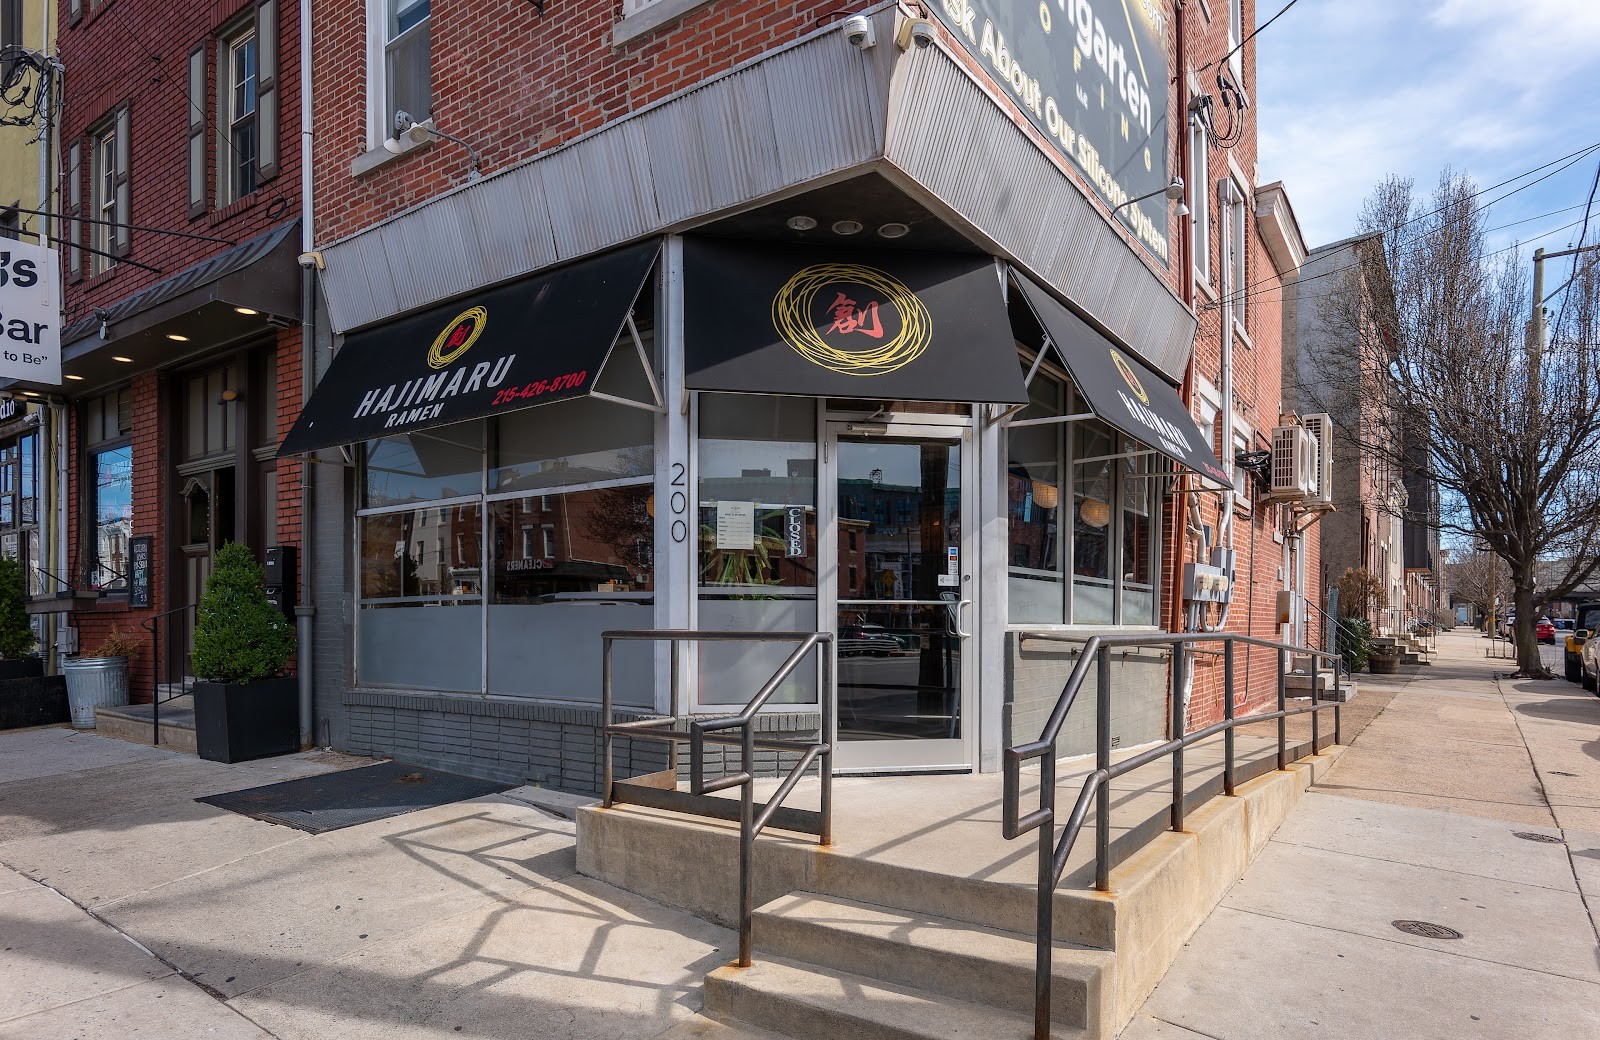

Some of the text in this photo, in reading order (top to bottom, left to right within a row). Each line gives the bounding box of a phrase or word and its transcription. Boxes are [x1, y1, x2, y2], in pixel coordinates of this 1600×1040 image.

[980, 18, 1042, 120] About
[1044, 96, 1076, 156] Our
[1077, 133, 1128, 218] Silicone
[1129, 196, 1168, 262] System
[0, 311, 49, 345] ar
[4, 350, 18, 362] to
[353, 354, 516, 419] HAJIMARU
[491, 370, 587, 406] 215-426-8700
[384, 402, 444, 429] RAMEN
[670, 462, 687, 543] 200
[788, 508, 802, 556] CLOSED
